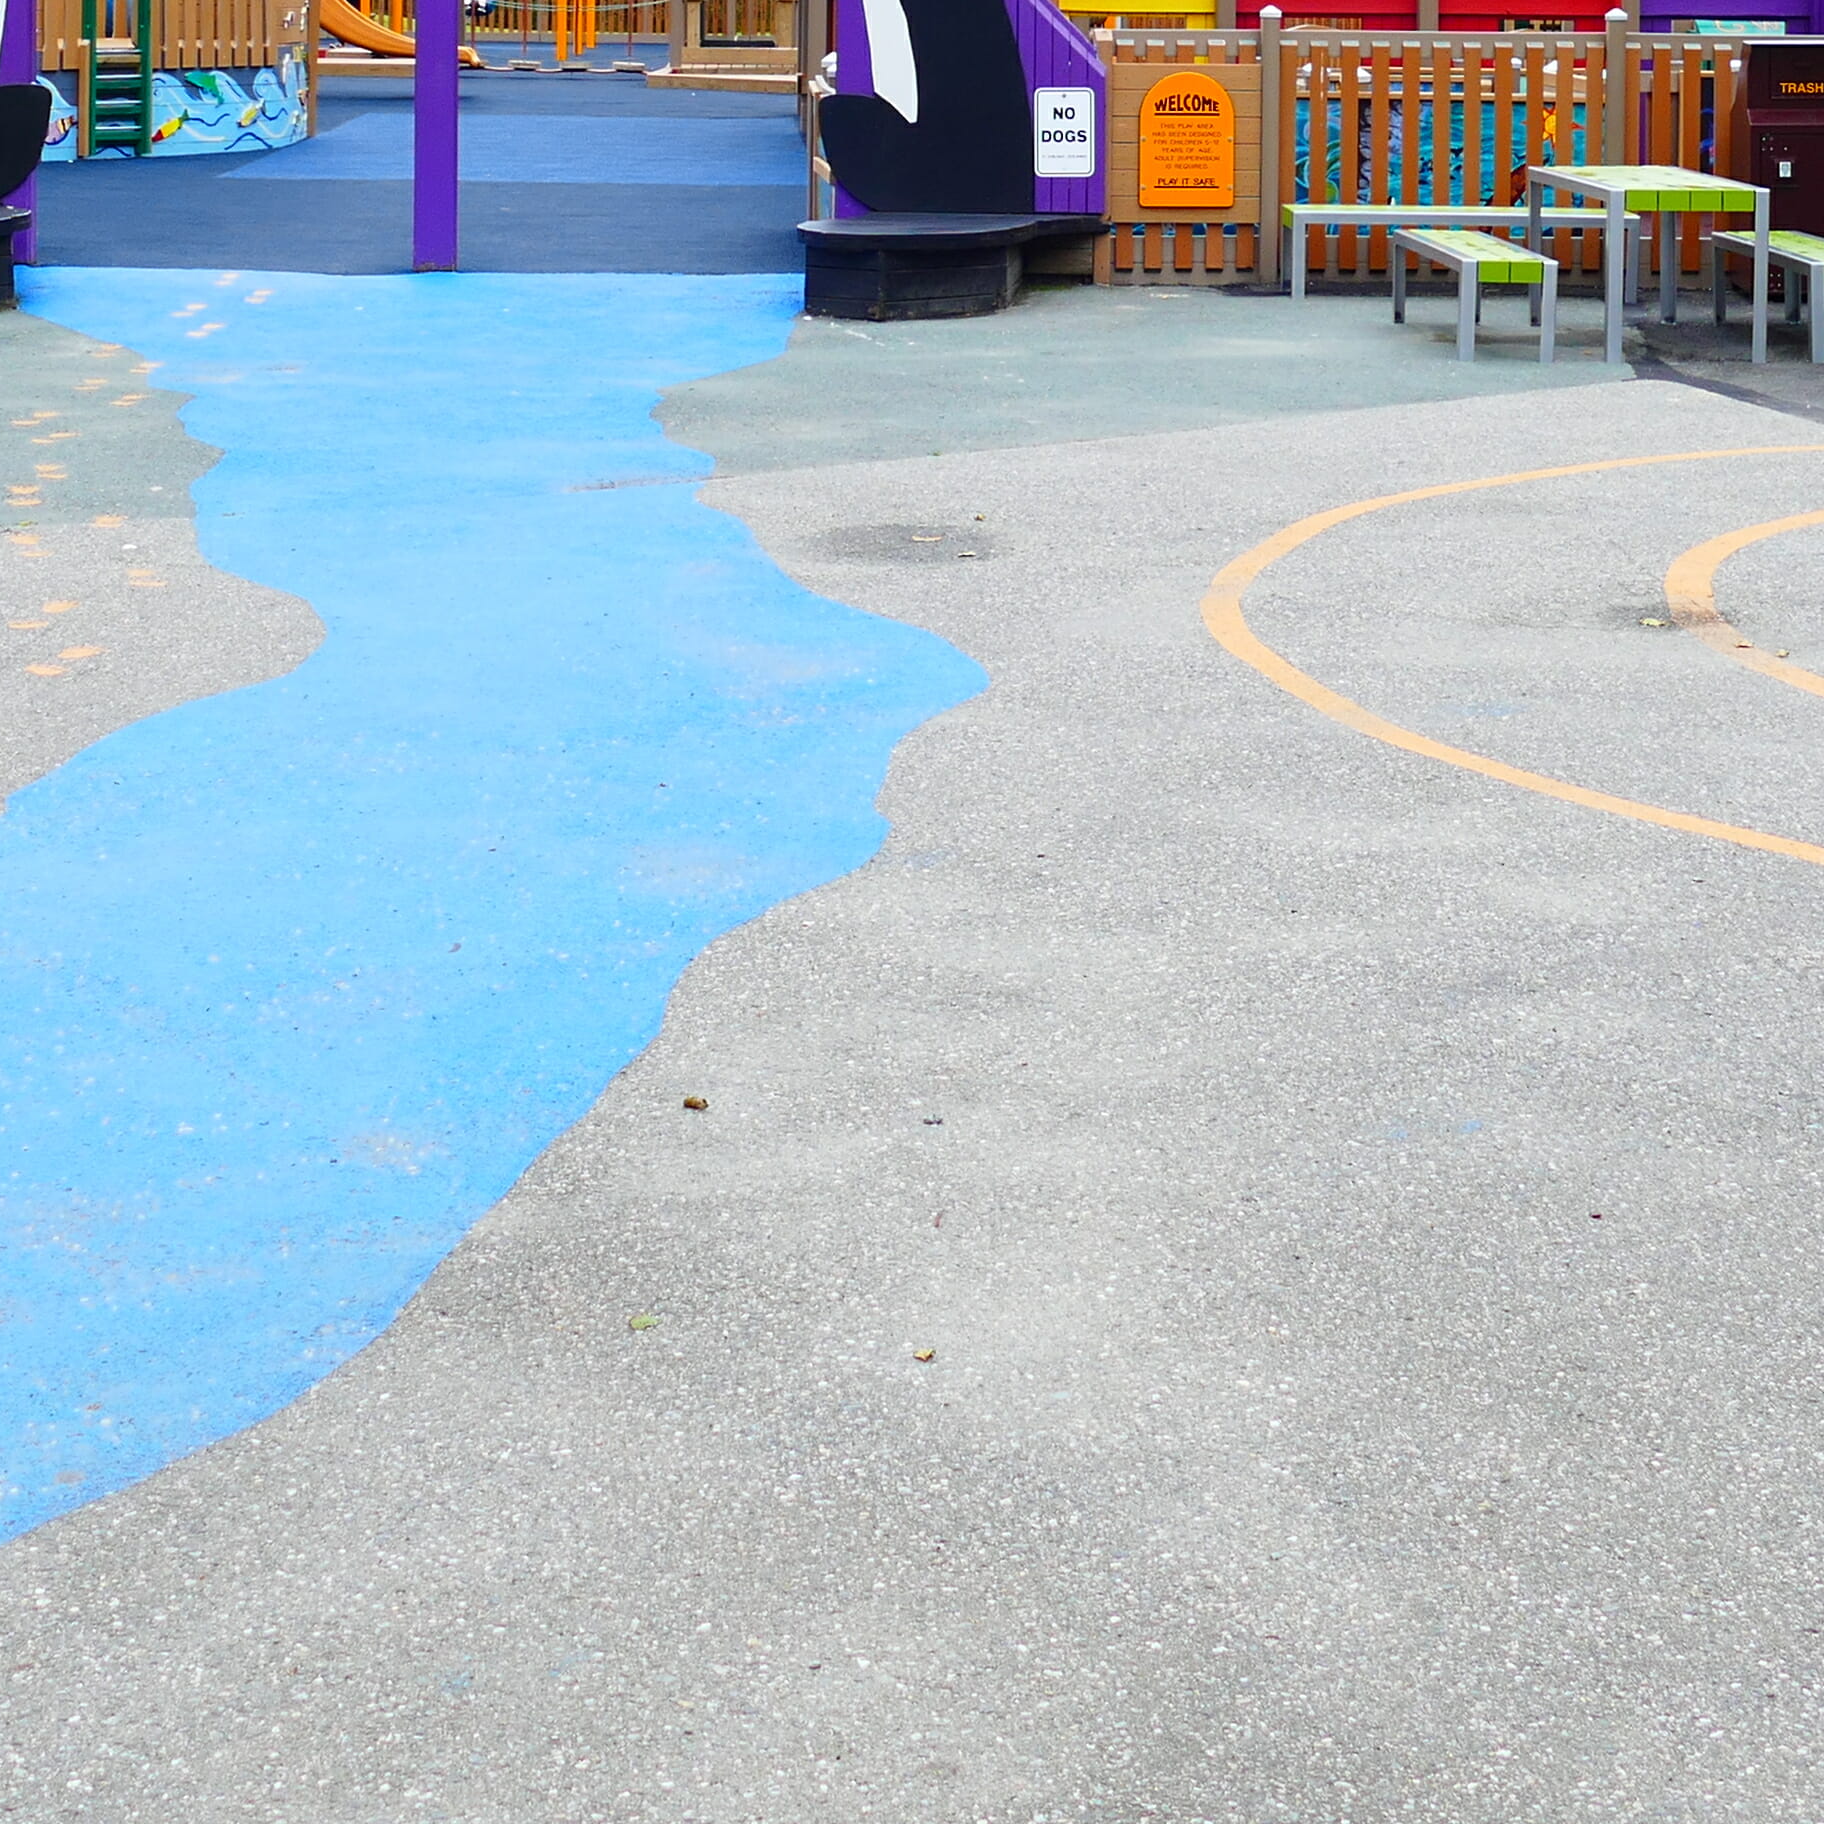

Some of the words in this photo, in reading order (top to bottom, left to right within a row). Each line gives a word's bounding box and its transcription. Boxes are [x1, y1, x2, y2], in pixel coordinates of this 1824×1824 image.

[1779, 82, 1824, 93] TRASH
[1154, 94, 1220, 111] WELCOME
[1053, 107, 1075, 120] NO
[1041, 130, 1087, 143] DOGS
[1157, 178, 1178, 186] PLAY
[1181, 178, 1190, 186] IT
[1193, 178, 1215, 186] SAFE
